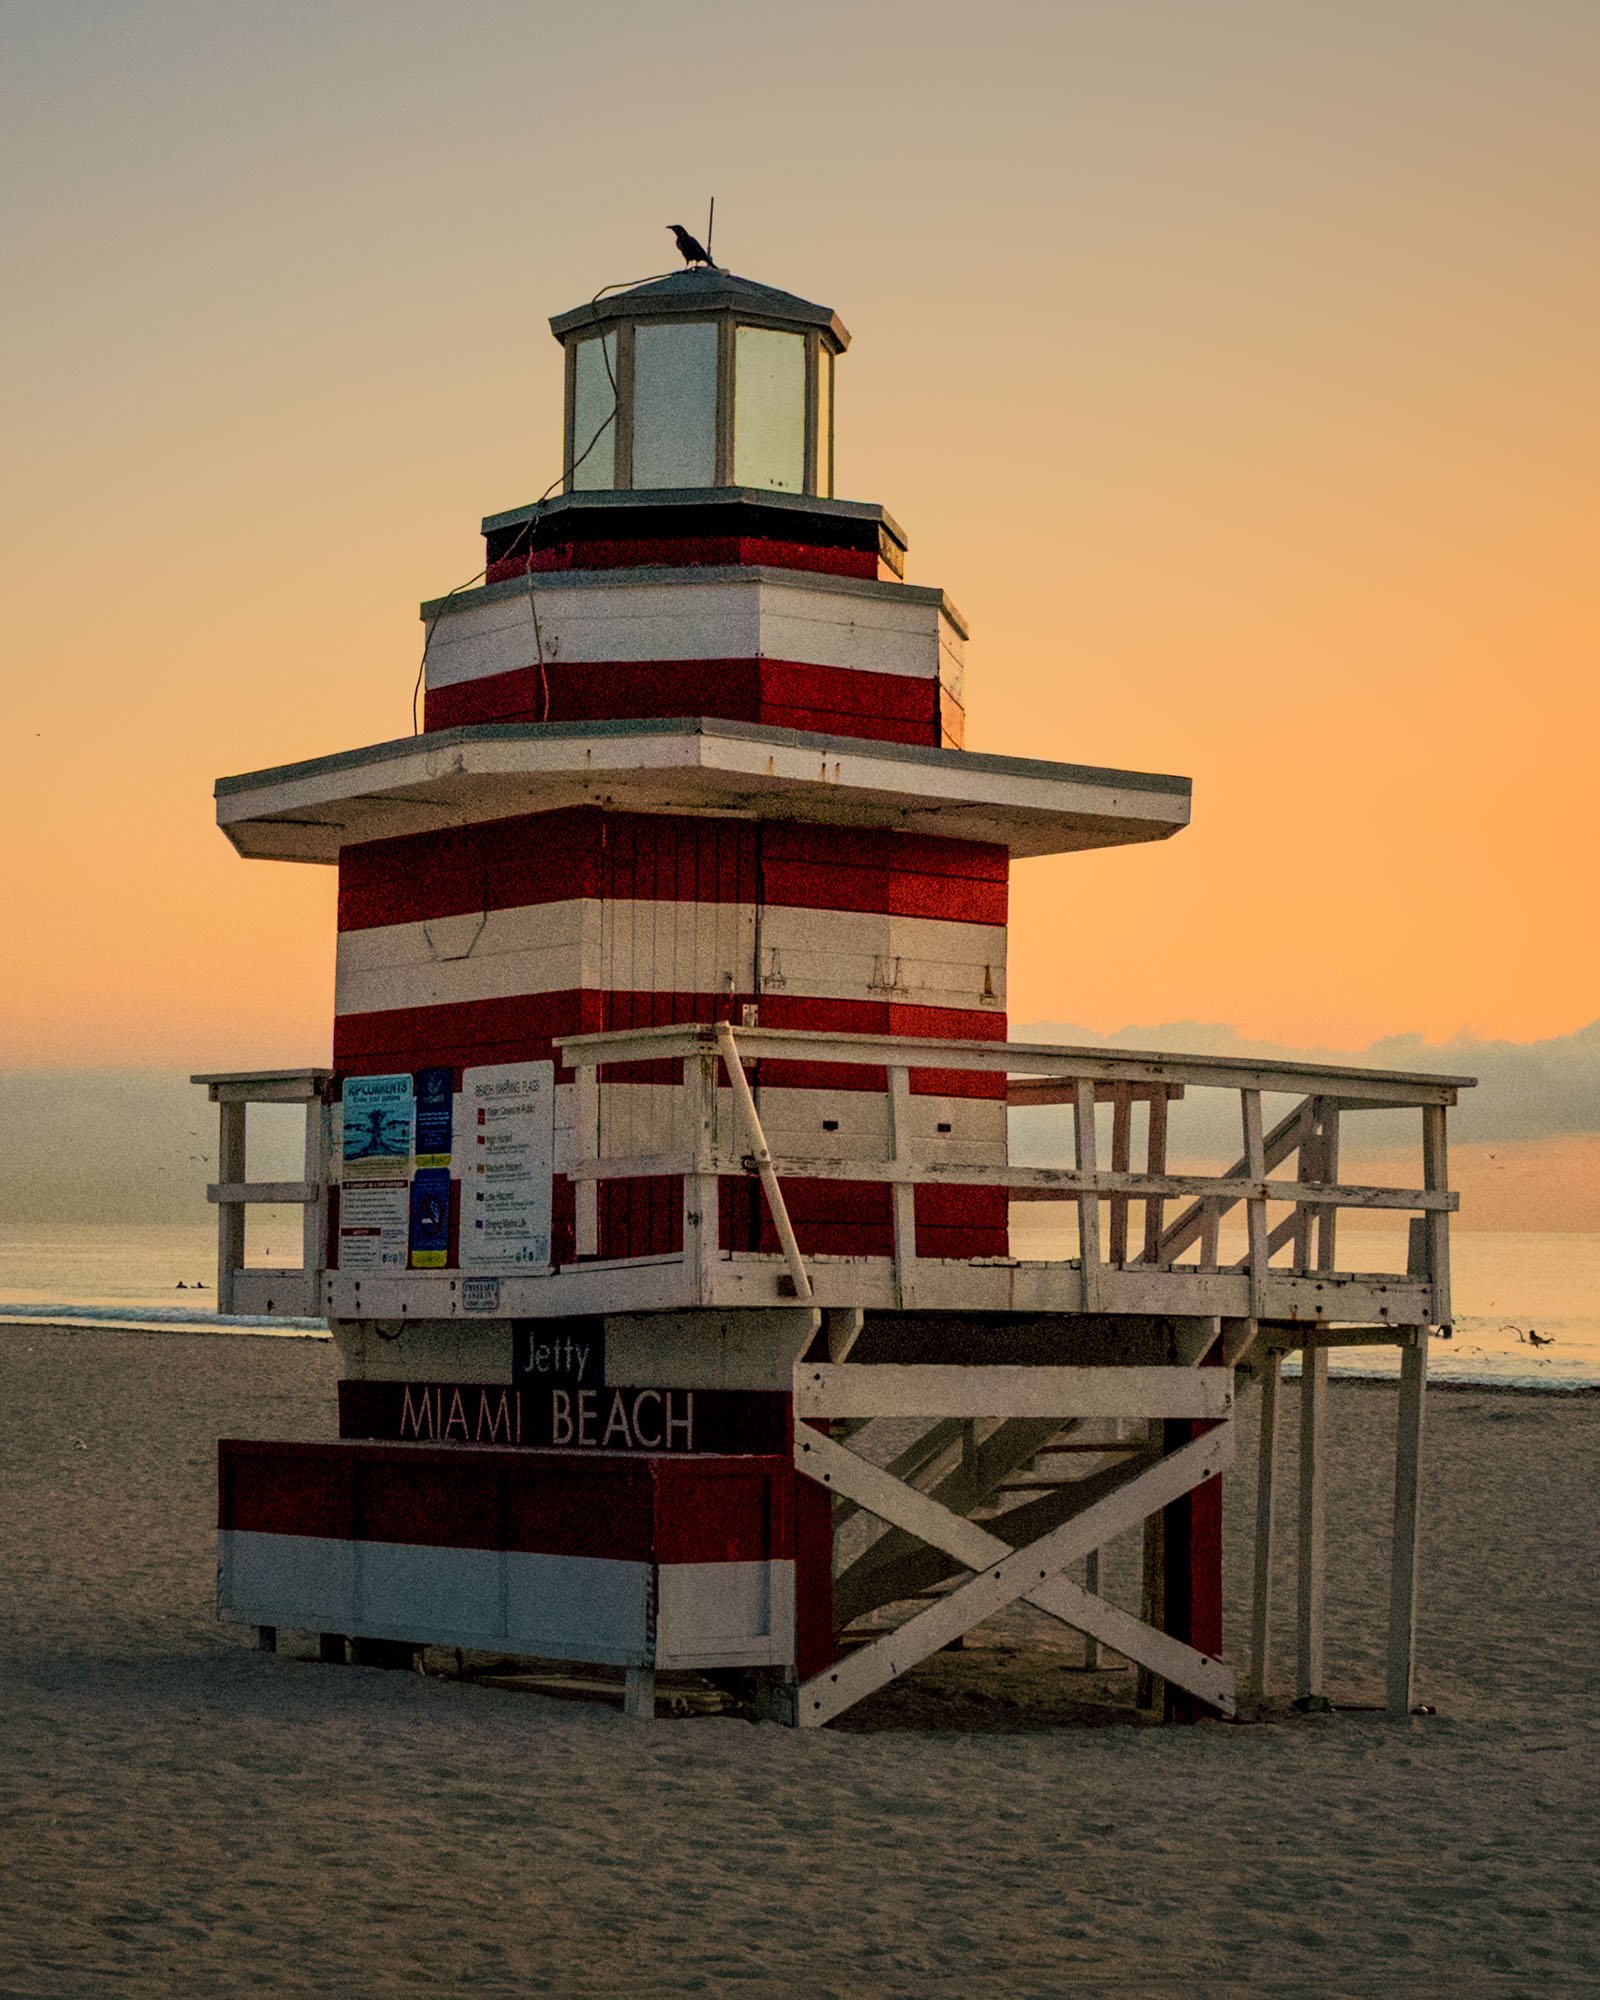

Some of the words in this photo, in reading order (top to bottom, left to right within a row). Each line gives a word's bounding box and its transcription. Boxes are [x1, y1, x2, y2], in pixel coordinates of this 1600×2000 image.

[524, 1331, 591, 1382] Jetty
[400, 1384, 521, 1443] MIAMI
[552, 1389, 694, 1450] BEACH
